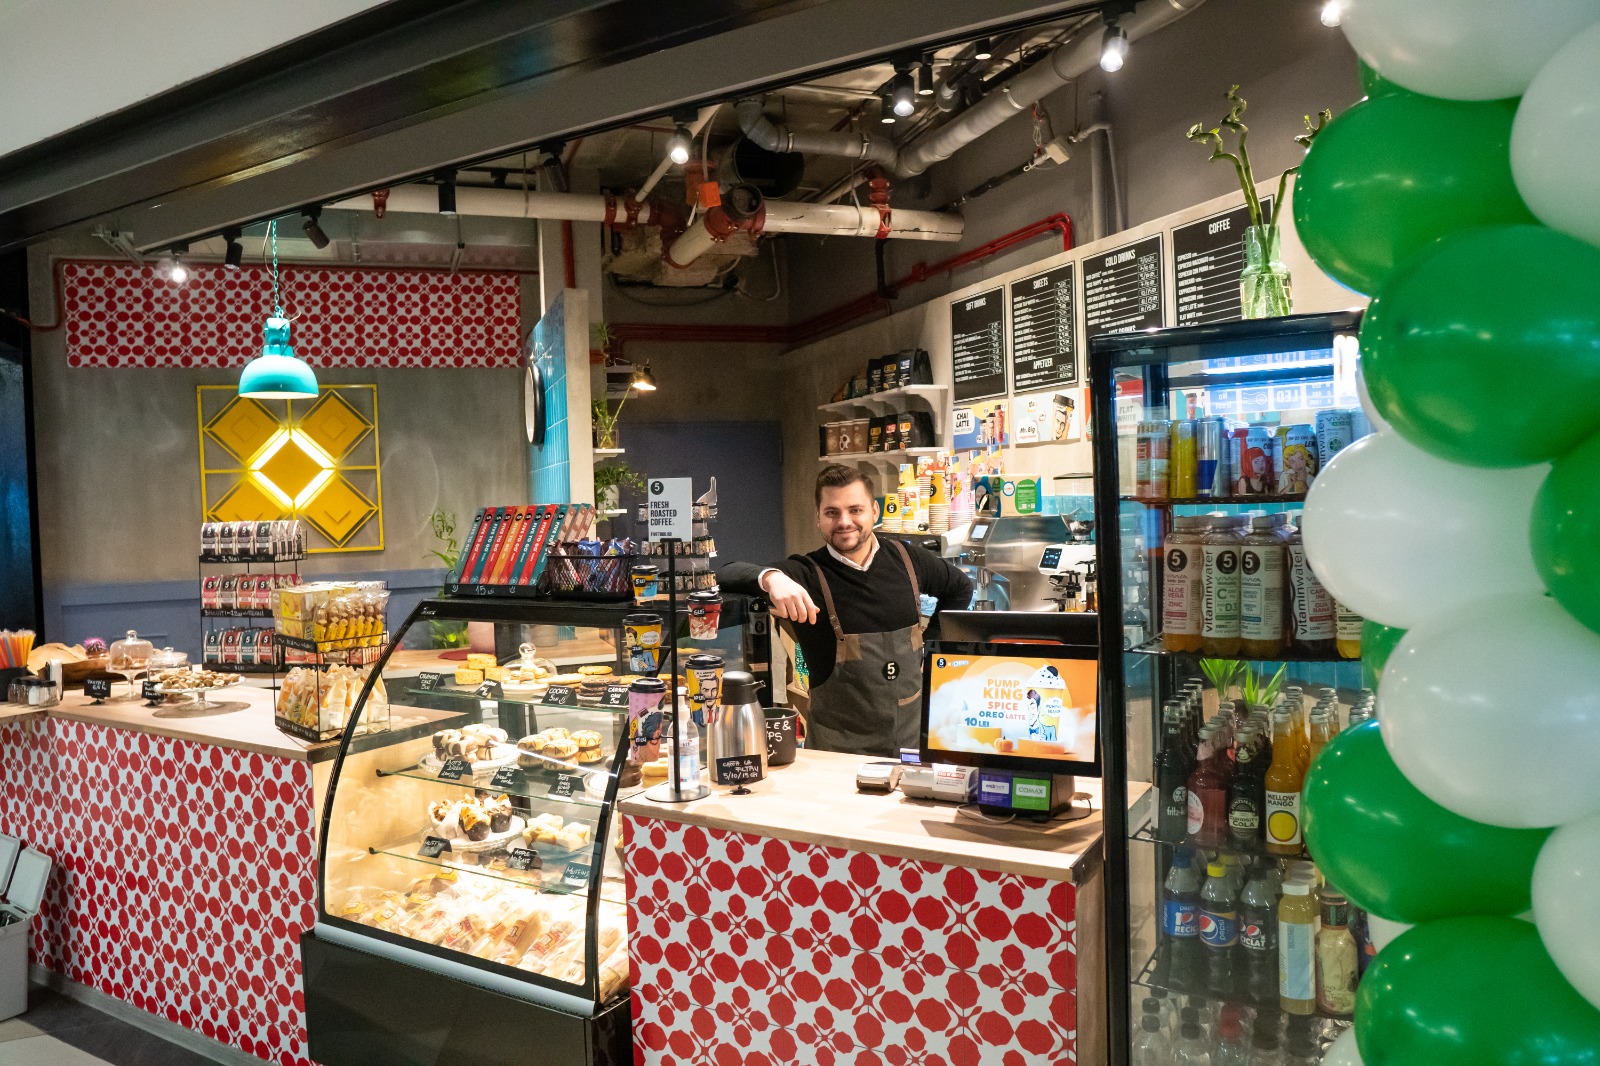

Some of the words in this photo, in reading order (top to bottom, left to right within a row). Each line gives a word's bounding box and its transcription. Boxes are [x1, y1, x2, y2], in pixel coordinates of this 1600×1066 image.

[1208, 217, 1231, 235] COFFEE
[1105, 254, 1118, 268] COLD
[1118, 249, 1136, 264] DRINKS
[1033, 276, 1049, 290] SWEETS
[1033, 357, 1054, 370] APPETIZER
[1120, 406, 1134, 414] FLAT
[956, 412, 969, 420] CHAI
[1118, 414, 1136, 423] WHITE
[956, 420, 970, 428] LATTE
[1028, 426, 1036, 434] Big
[654, 482, 660, 492] 5
[650, 501, 670, 509] FRESH
[650, 510, 678, 518] ROASTED
[1171, 552, 1181, 566] 5
[1223, 554, 1232, 568] 5
[1245, 554, 1254, 568] 5
[476, 584, 486, 596] 15
[1205, 550, 1213, 632] vitaminwater
[1217, 588, 1228, 600] C
[1294, 550, 1308, 636] vitaminwater
[1225, 603, 1238, 612] D3
[888, 662, 896, 675] 5
[987, 679, 1020, 688] PUMP
[983, 688, 1023, 700] KING
[988, 702, 1018, 710] SPICE
[979, 711, 1004, 719] OREO
[782, 720, 791, 730] &
[965, 718, 978, 726] 10
